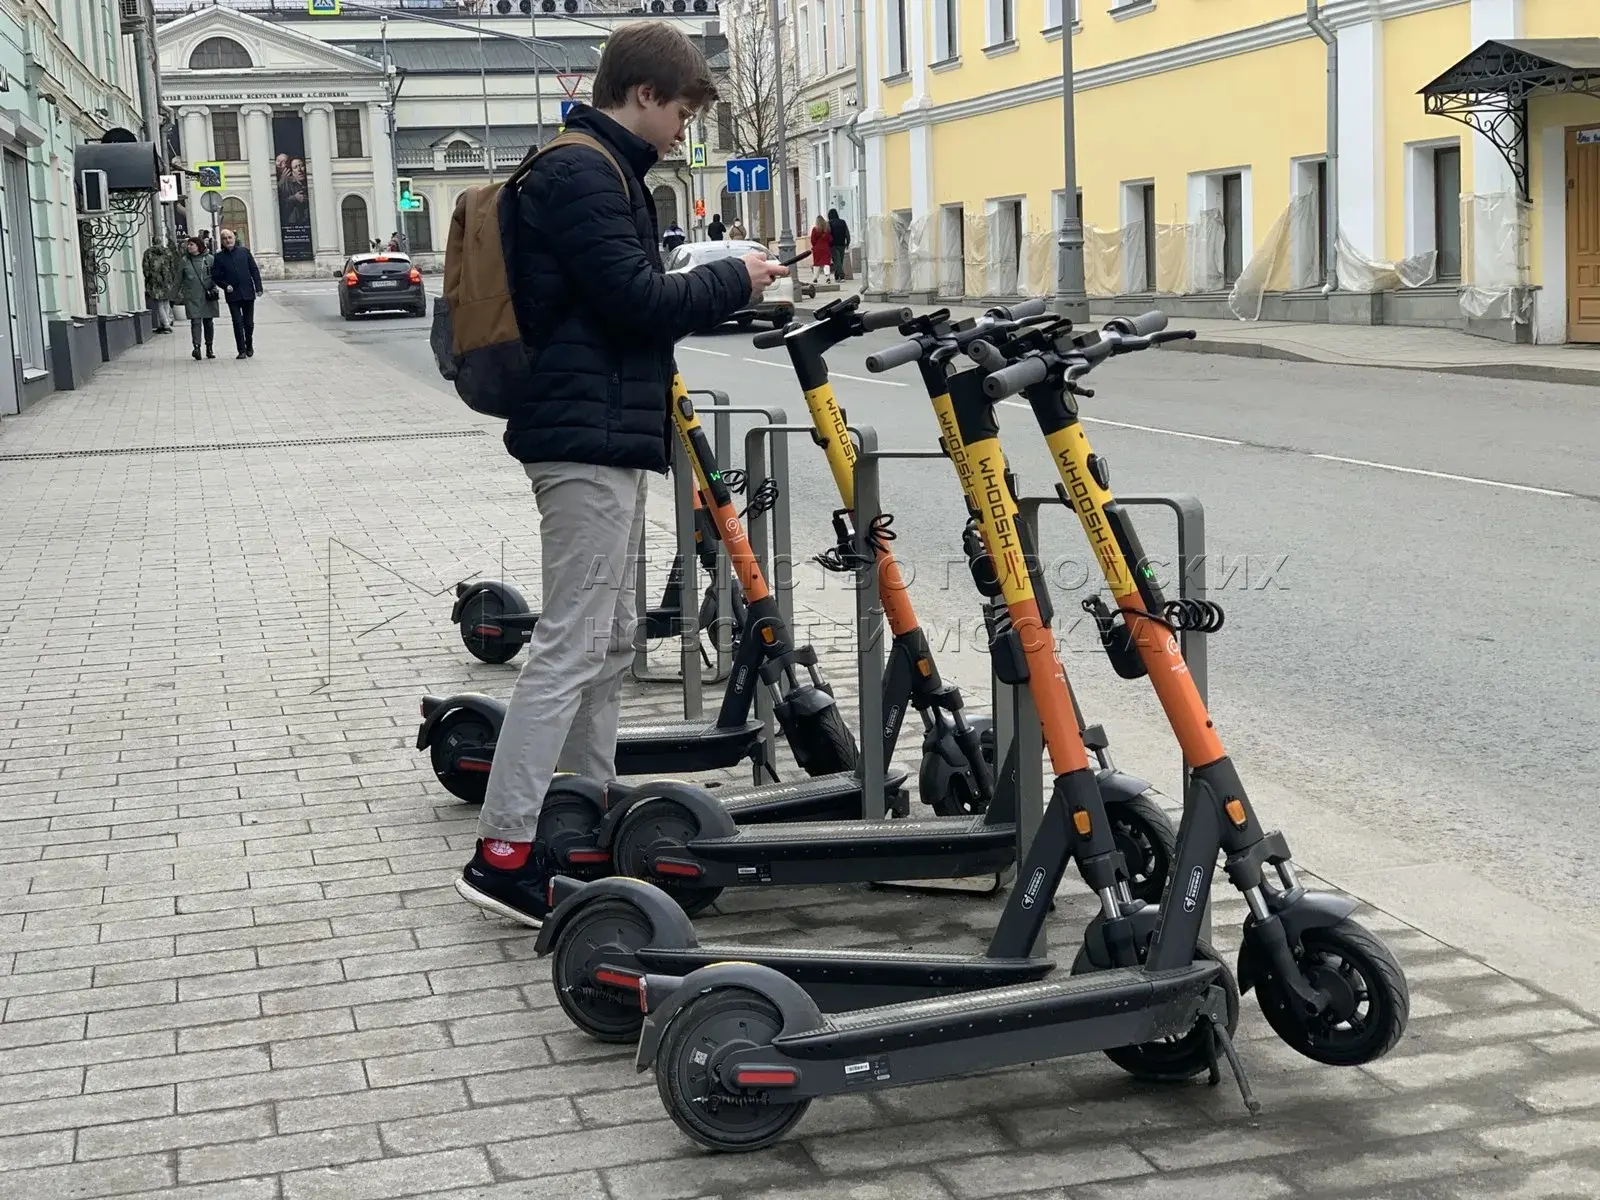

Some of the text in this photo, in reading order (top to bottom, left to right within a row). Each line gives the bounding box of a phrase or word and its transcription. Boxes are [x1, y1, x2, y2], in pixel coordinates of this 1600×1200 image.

[826, 397, 856, 469] WHOOSH
[939, 411, 975, 489] WHOOSH
[978, 456, 1014, 549] WHOOSH
[1058, 448, 1109, 544] WHOOSH
